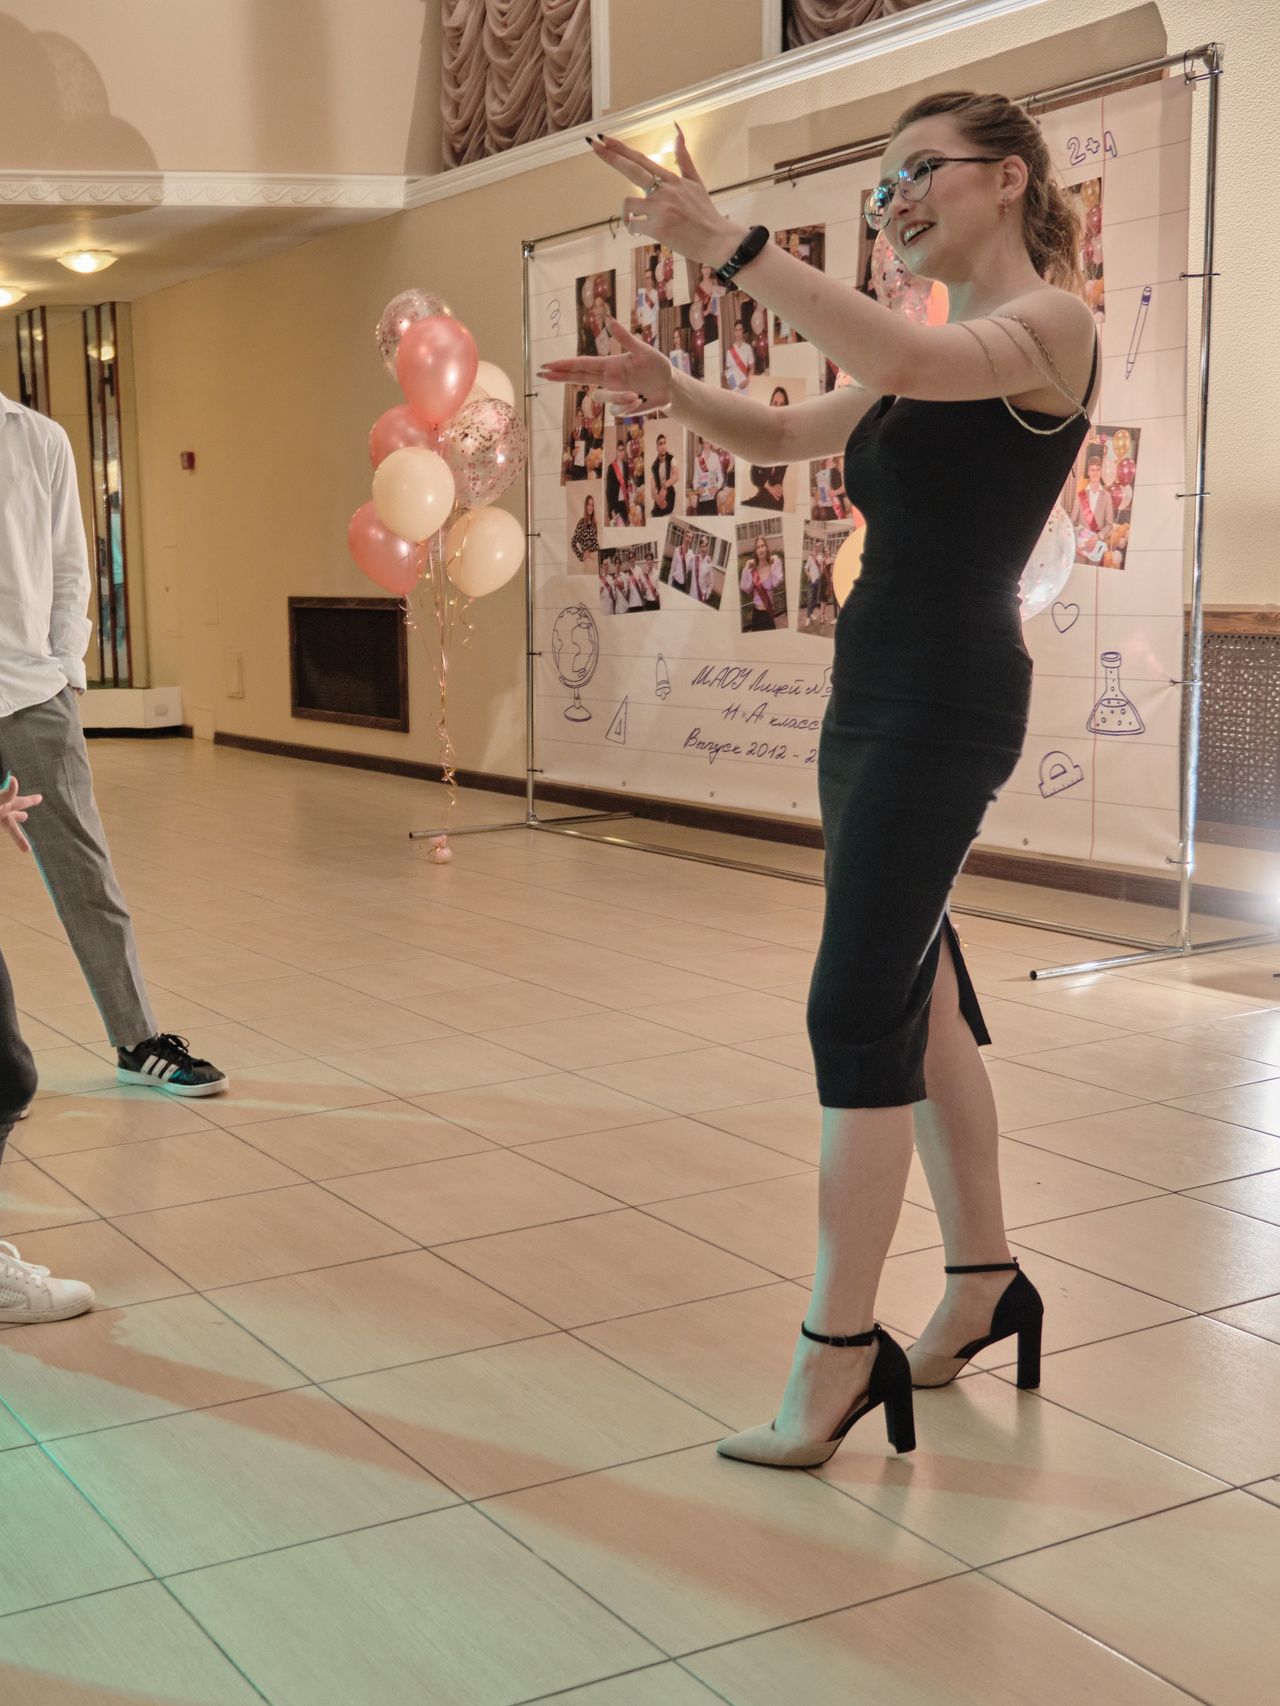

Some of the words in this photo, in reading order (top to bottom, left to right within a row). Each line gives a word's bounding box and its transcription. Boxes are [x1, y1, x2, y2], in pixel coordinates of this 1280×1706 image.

[691, 664, 754, 691] МАОУ
[748, 669, 804, 697] Лицей
[722, 702, 742, 720] 11
[769, 716, 819, 730] класс
[683, 727, 742, 765] Выпуск
[746, 741, 787, 760] 2012
